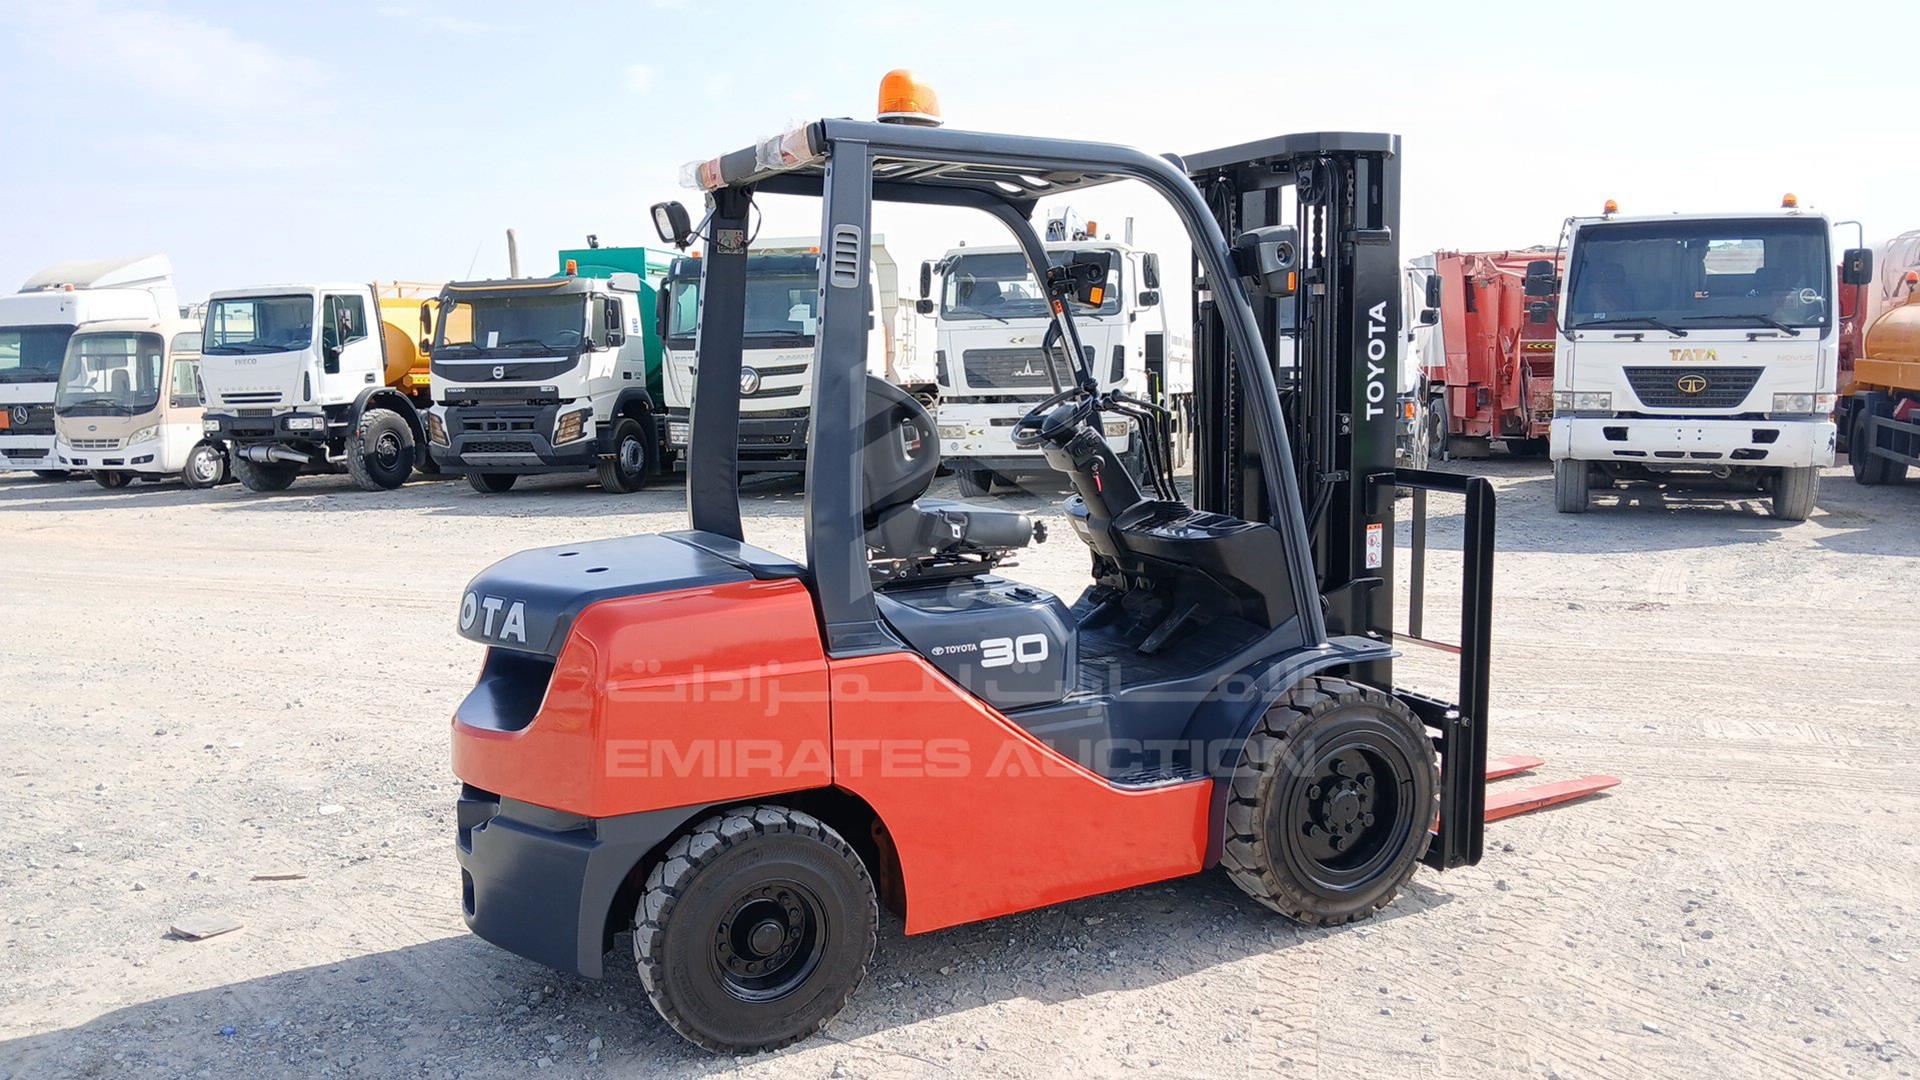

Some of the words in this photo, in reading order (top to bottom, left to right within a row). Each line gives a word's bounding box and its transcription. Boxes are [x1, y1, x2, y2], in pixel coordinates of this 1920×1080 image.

[234, 358, 257, 366] IVECO
[1366, 301, 1387, 421] TOYOTA
[1669, 348, 1718, 361] TATA
[945, 643, 978, 654] TOYOTA
[980, 633, 1048, 668] 30
